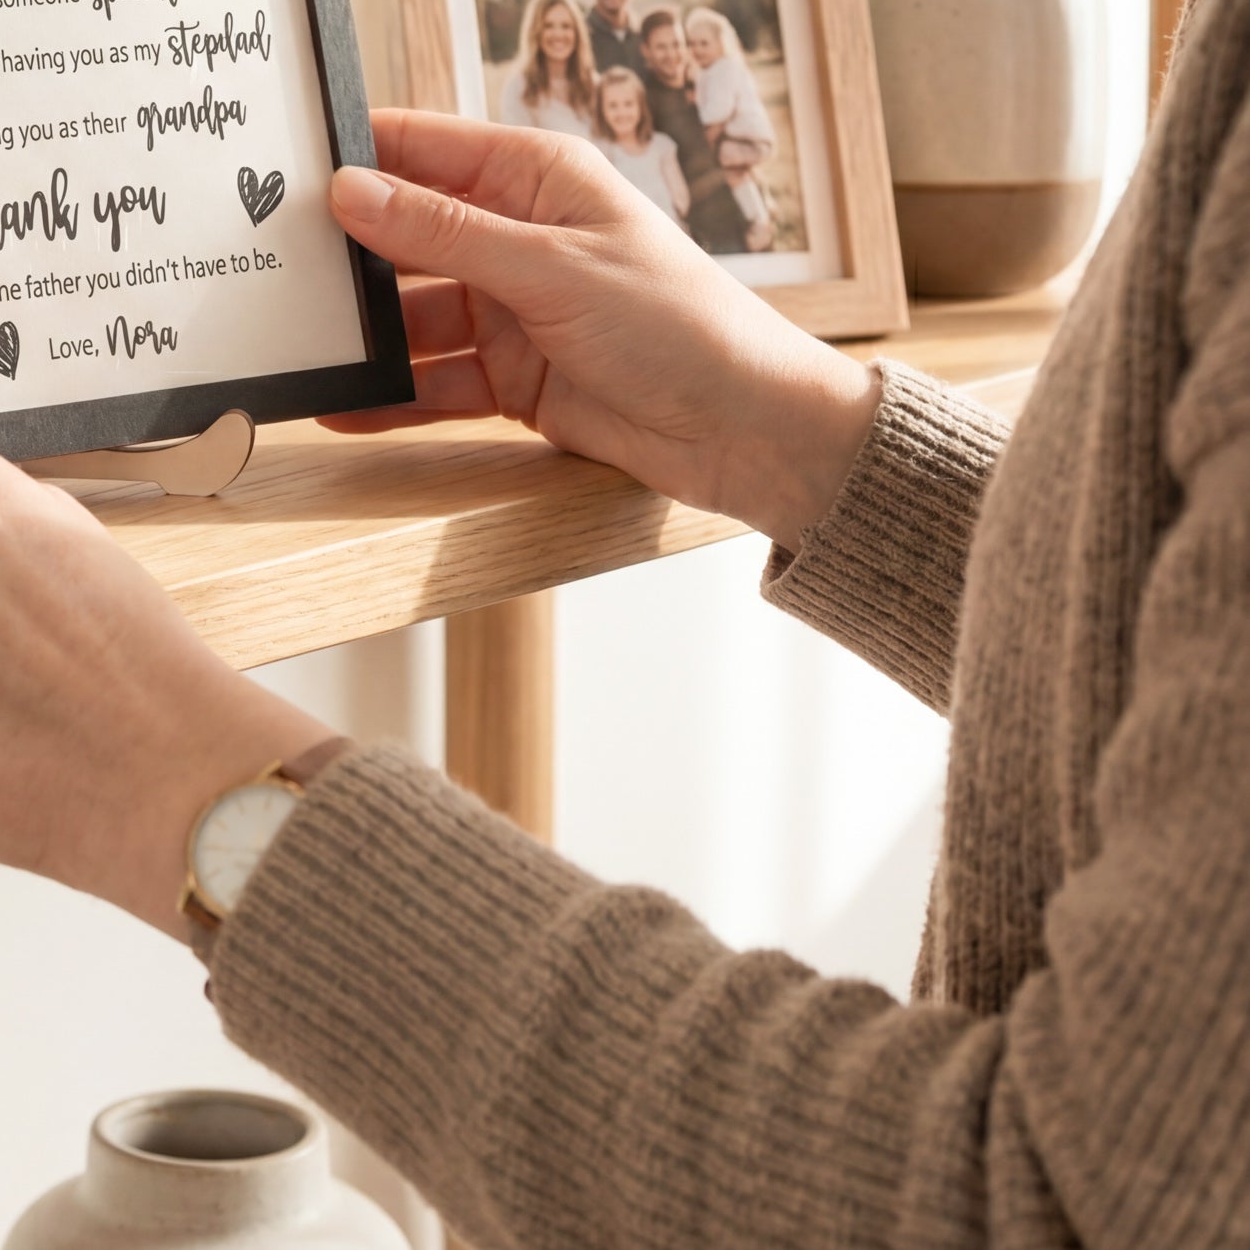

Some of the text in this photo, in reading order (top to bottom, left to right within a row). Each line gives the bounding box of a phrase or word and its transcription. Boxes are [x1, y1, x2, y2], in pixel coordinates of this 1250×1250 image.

[1, 44, 67, 75] having
[69, 47, 104, 73] you
[109, 45, 129, 65] as
[134, 43, 161, 66] my
[18, 124, 54, 150] you
[58, 120, 79, 139] as
[136, 84, 247, 152] grandpa
[93, 184, 166, 253] you
[25, 271, 82, 299] father
[85, 271, 121, 298] you
[125, 257, 180, 287] didn't
[183, 254, 227, 280] have
[230, 253, 250, 274] to
[252, 247, 283, 272] be.
[48, 315, 178, 361] Love, Nora
